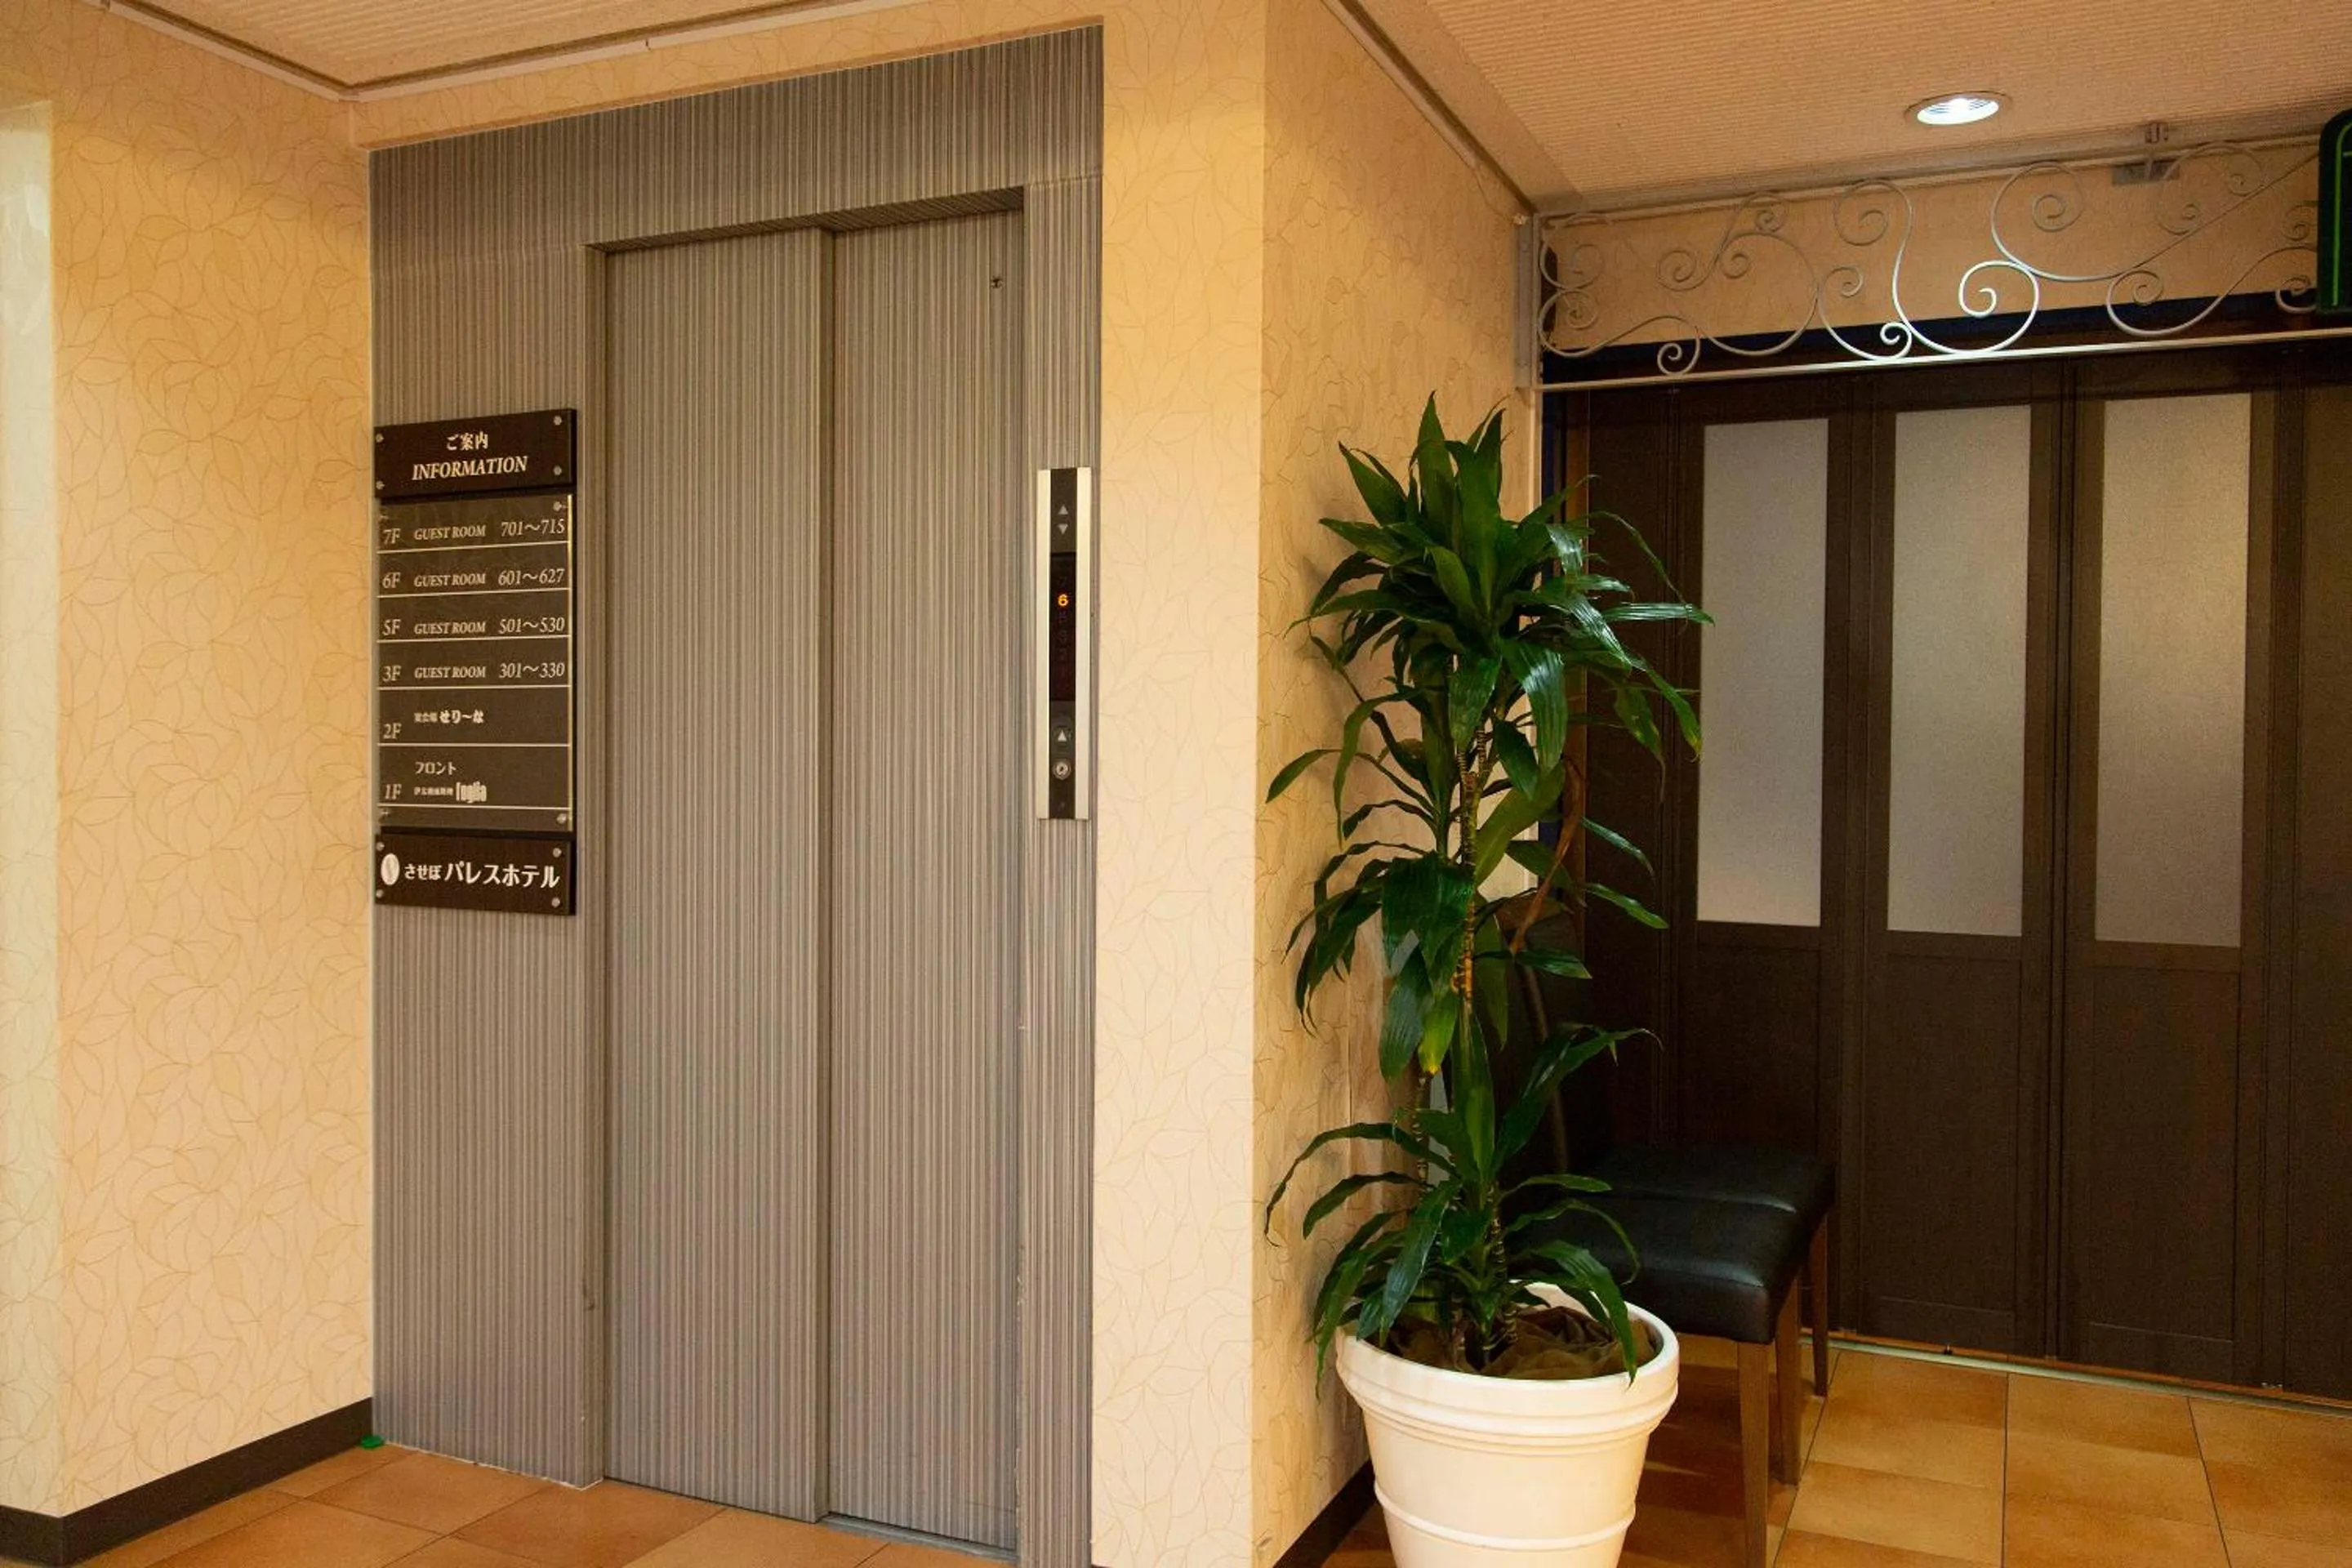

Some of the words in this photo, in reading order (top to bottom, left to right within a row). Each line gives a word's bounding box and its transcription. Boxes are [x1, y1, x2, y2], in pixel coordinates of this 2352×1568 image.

[447, 431, 488, 451] ご案内
[412, 456, 528, 480] INFORMATION
[383, 528, 400, 545] 7F
[414, 527, 451, 541] GUEST
[452, 525, 486, 537] ROOM
[382, 572, 401, 588] 6F
[414, 575, 451, 587] GUEST
[452, 573, 486, 586] ROOM
[1058, 593, 1069, 606] 6
[382, 619, 401, 635] 5F
[414, 622, 451, 635] GUEST
[452, 621, 486, 633] ROOM
[382, 666, 402, 682] 3F
[414, 666, 451, 679] GUEST
[452, 666, 486, 678] ROOM
[383, 723, 402, 739] 2F
[415, 761, 457, 775] フロント
[385, 783, 402, 800] 1F
